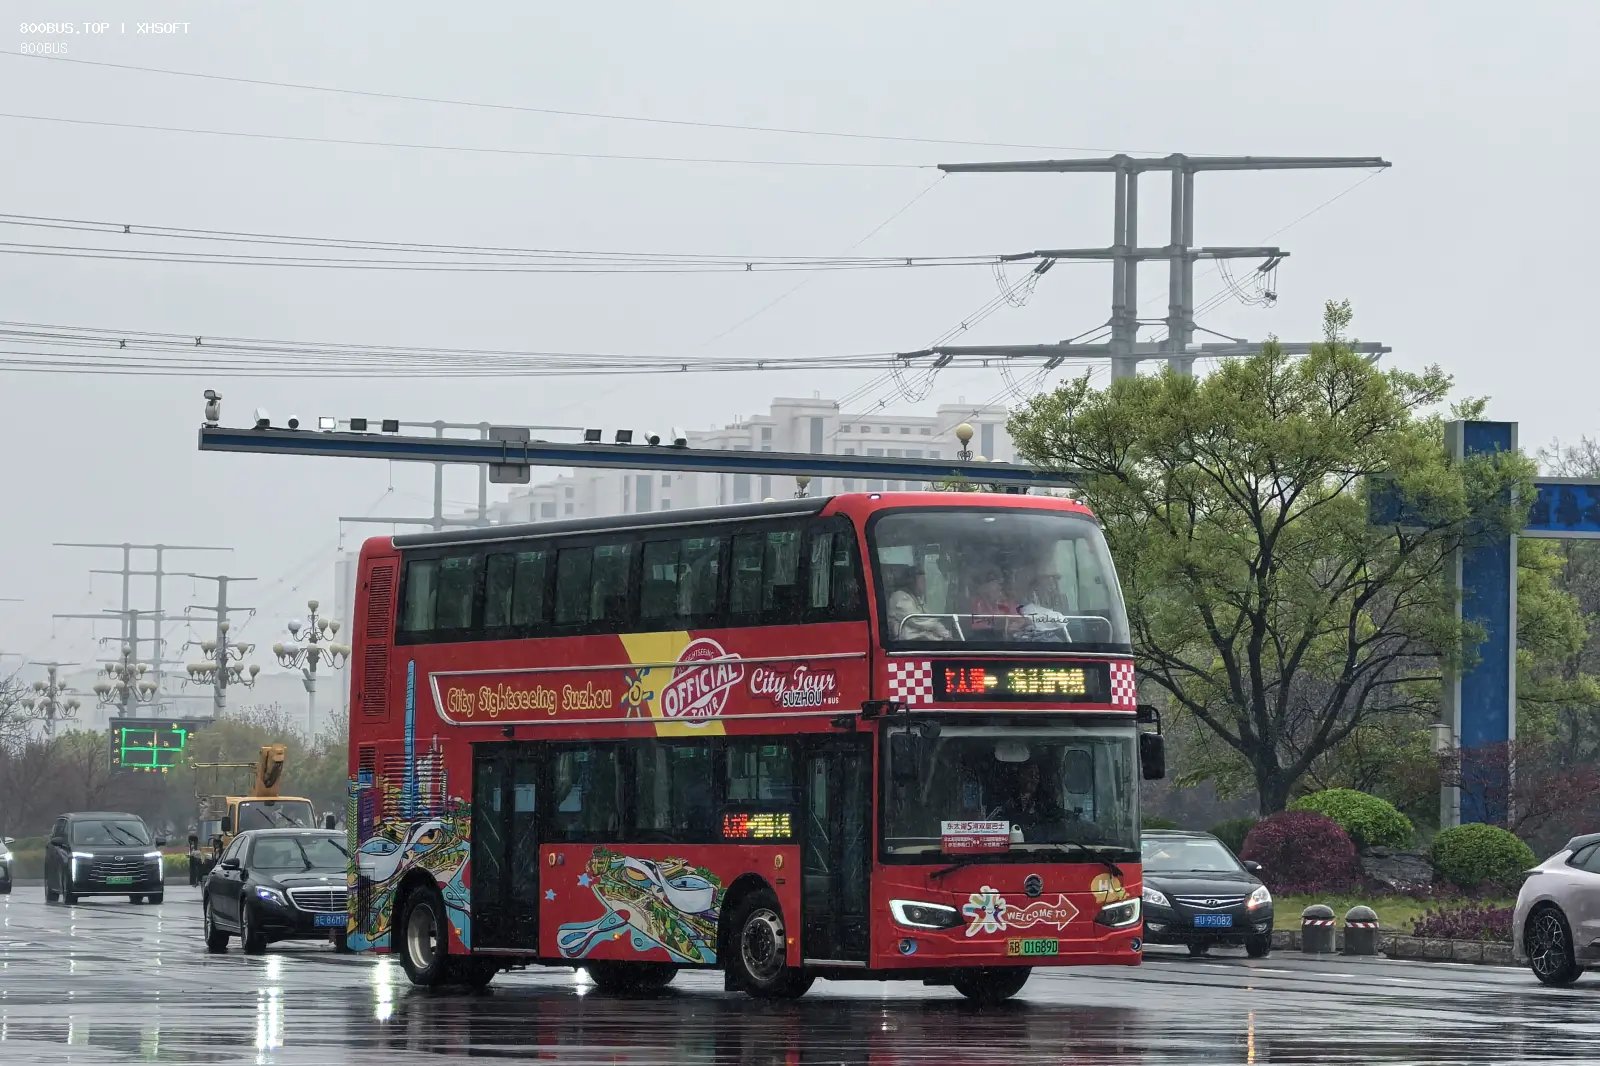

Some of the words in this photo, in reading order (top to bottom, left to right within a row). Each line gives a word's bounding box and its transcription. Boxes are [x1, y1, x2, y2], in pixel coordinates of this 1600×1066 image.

[684, 648, 715, 663] IGHTSEEING
[665, 663, 738, 717] OFFICIAL
[750, 668, 787, 702] City
[790, 665, 836, 693] Tour
[447, 687, 475, 718] City
[478, 683, 558, 718] Sightseeing
[562, 681, 612, 711] Suzhou
[692, 696, 719, 717] TOUR
[783, 689, 823, 708] SUZHOU
[1007, 907, 1053, 922] WELCOME
[1055, 909, 1067, 918] TO
